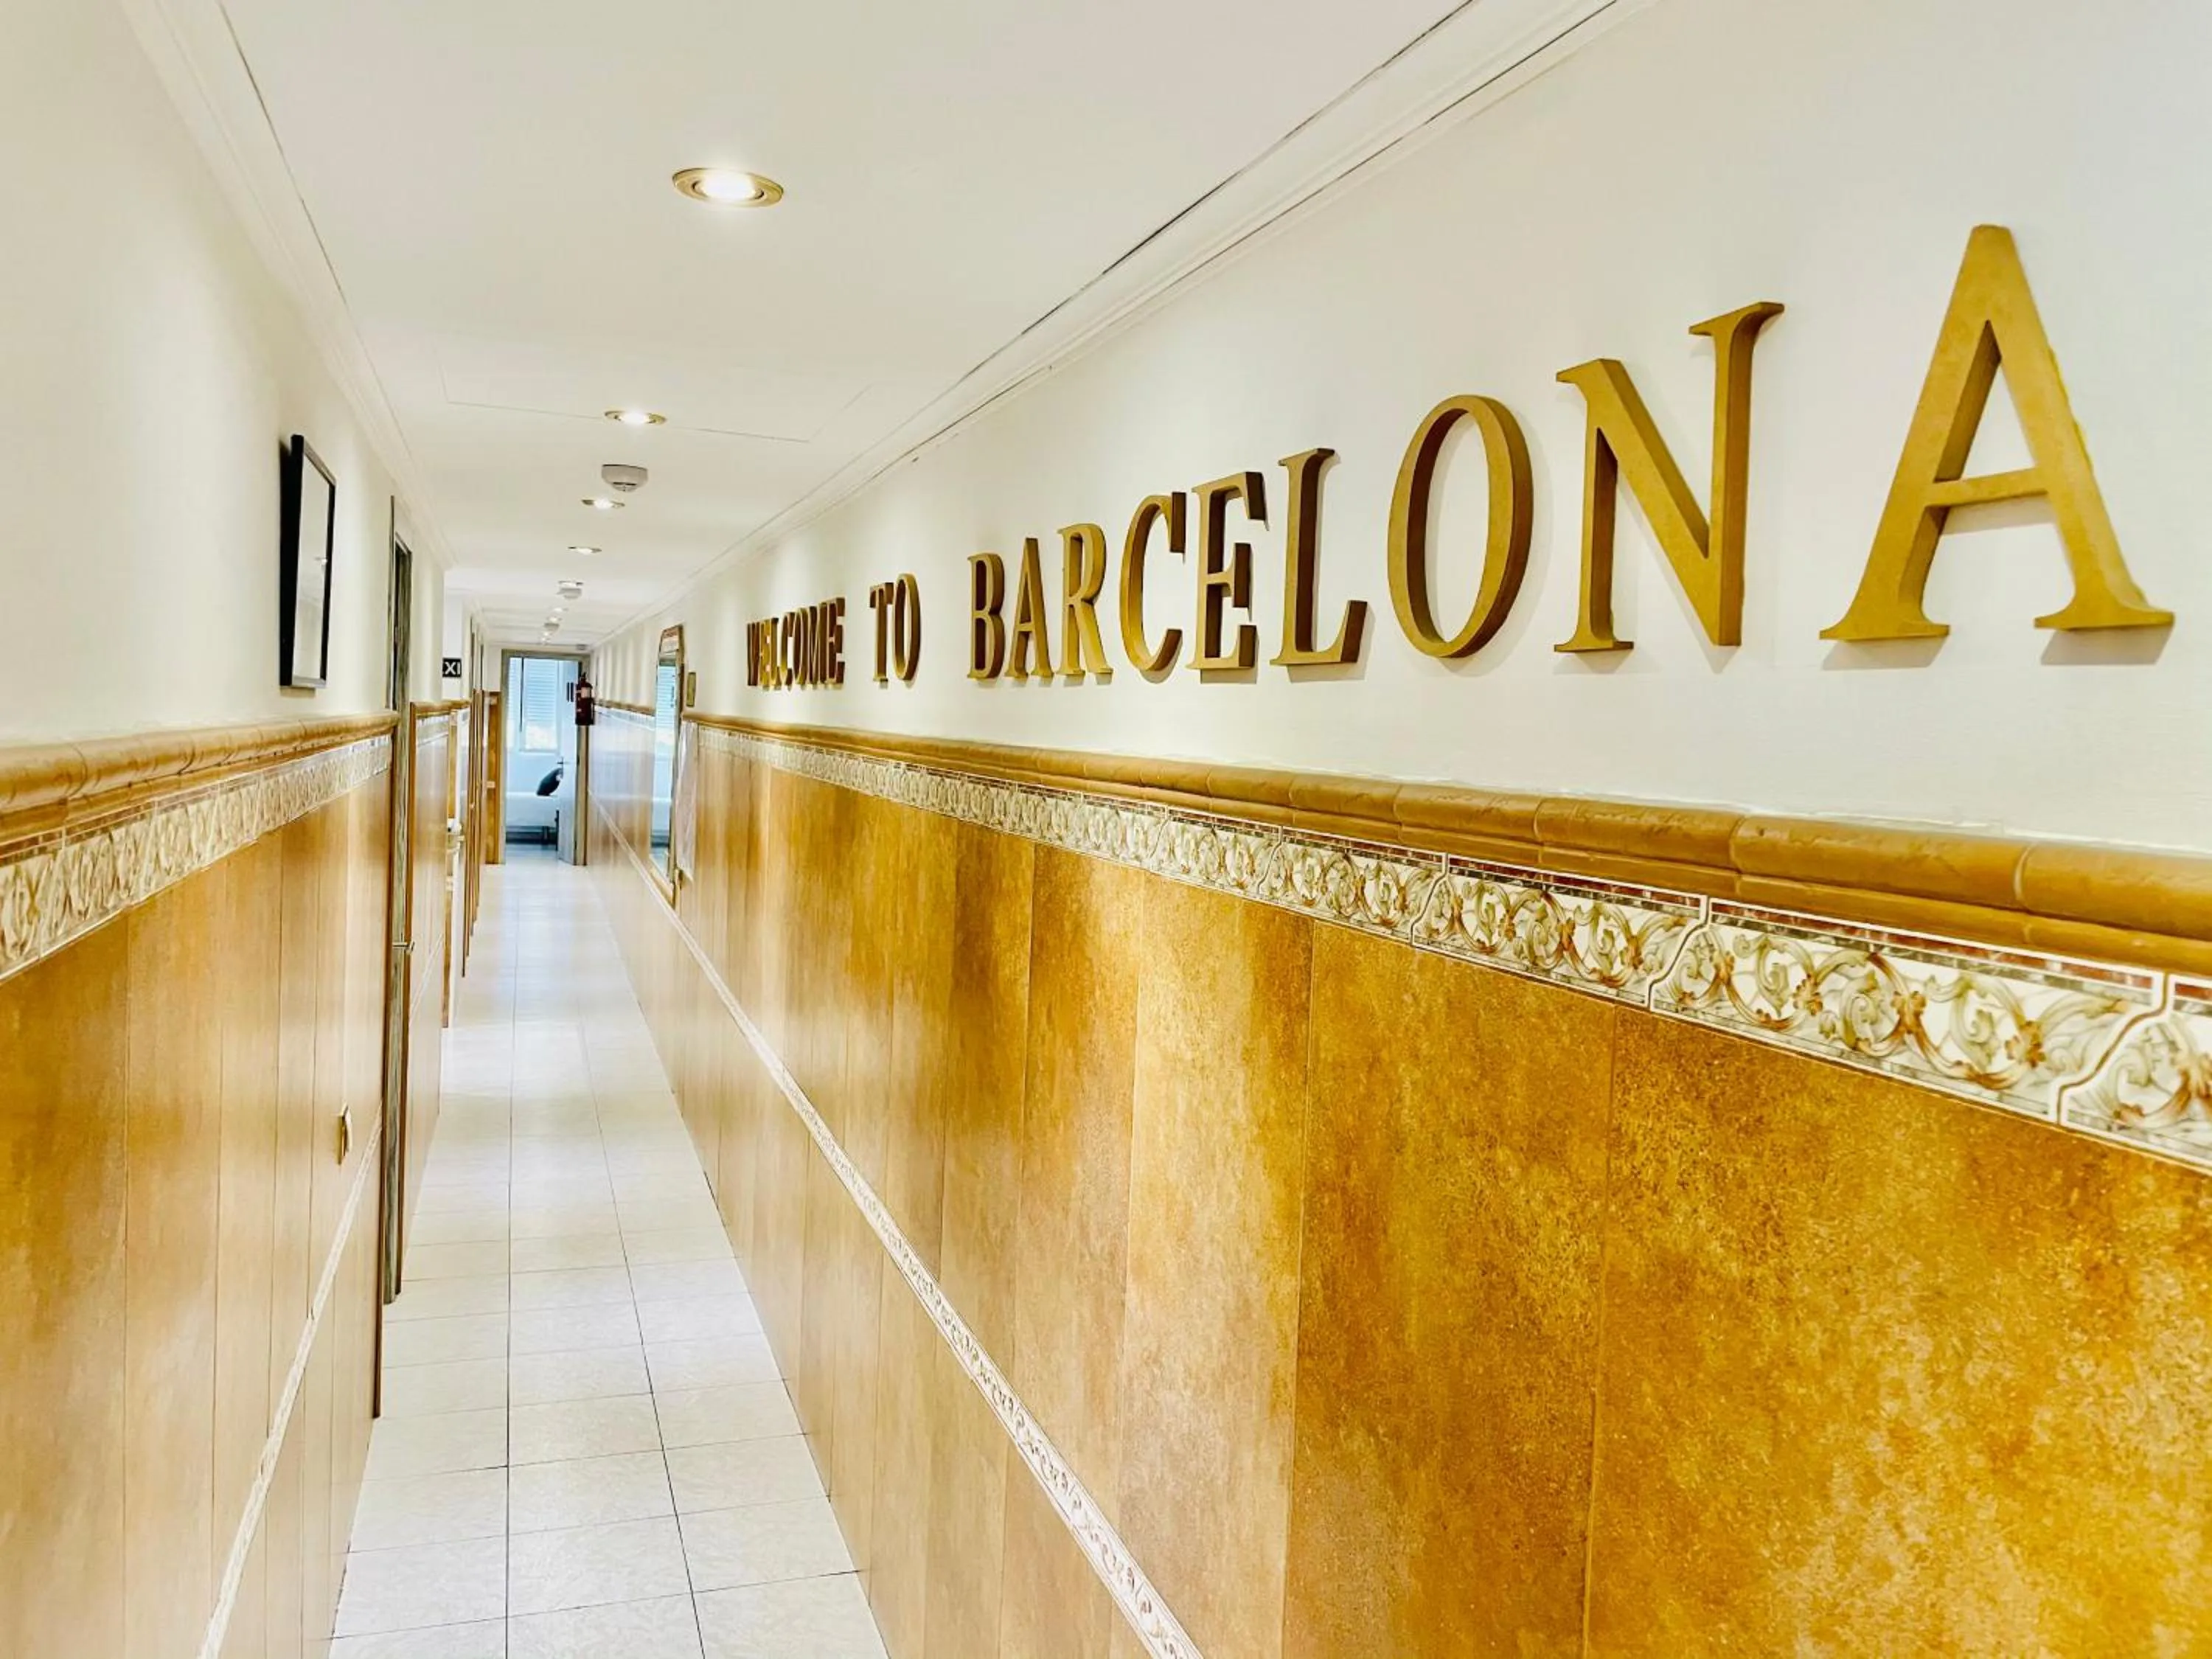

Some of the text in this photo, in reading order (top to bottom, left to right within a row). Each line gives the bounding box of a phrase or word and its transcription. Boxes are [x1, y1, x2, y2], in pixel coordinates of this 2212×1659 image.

[747, 223, 2175, 686] WELCOME TO BARCELONA
